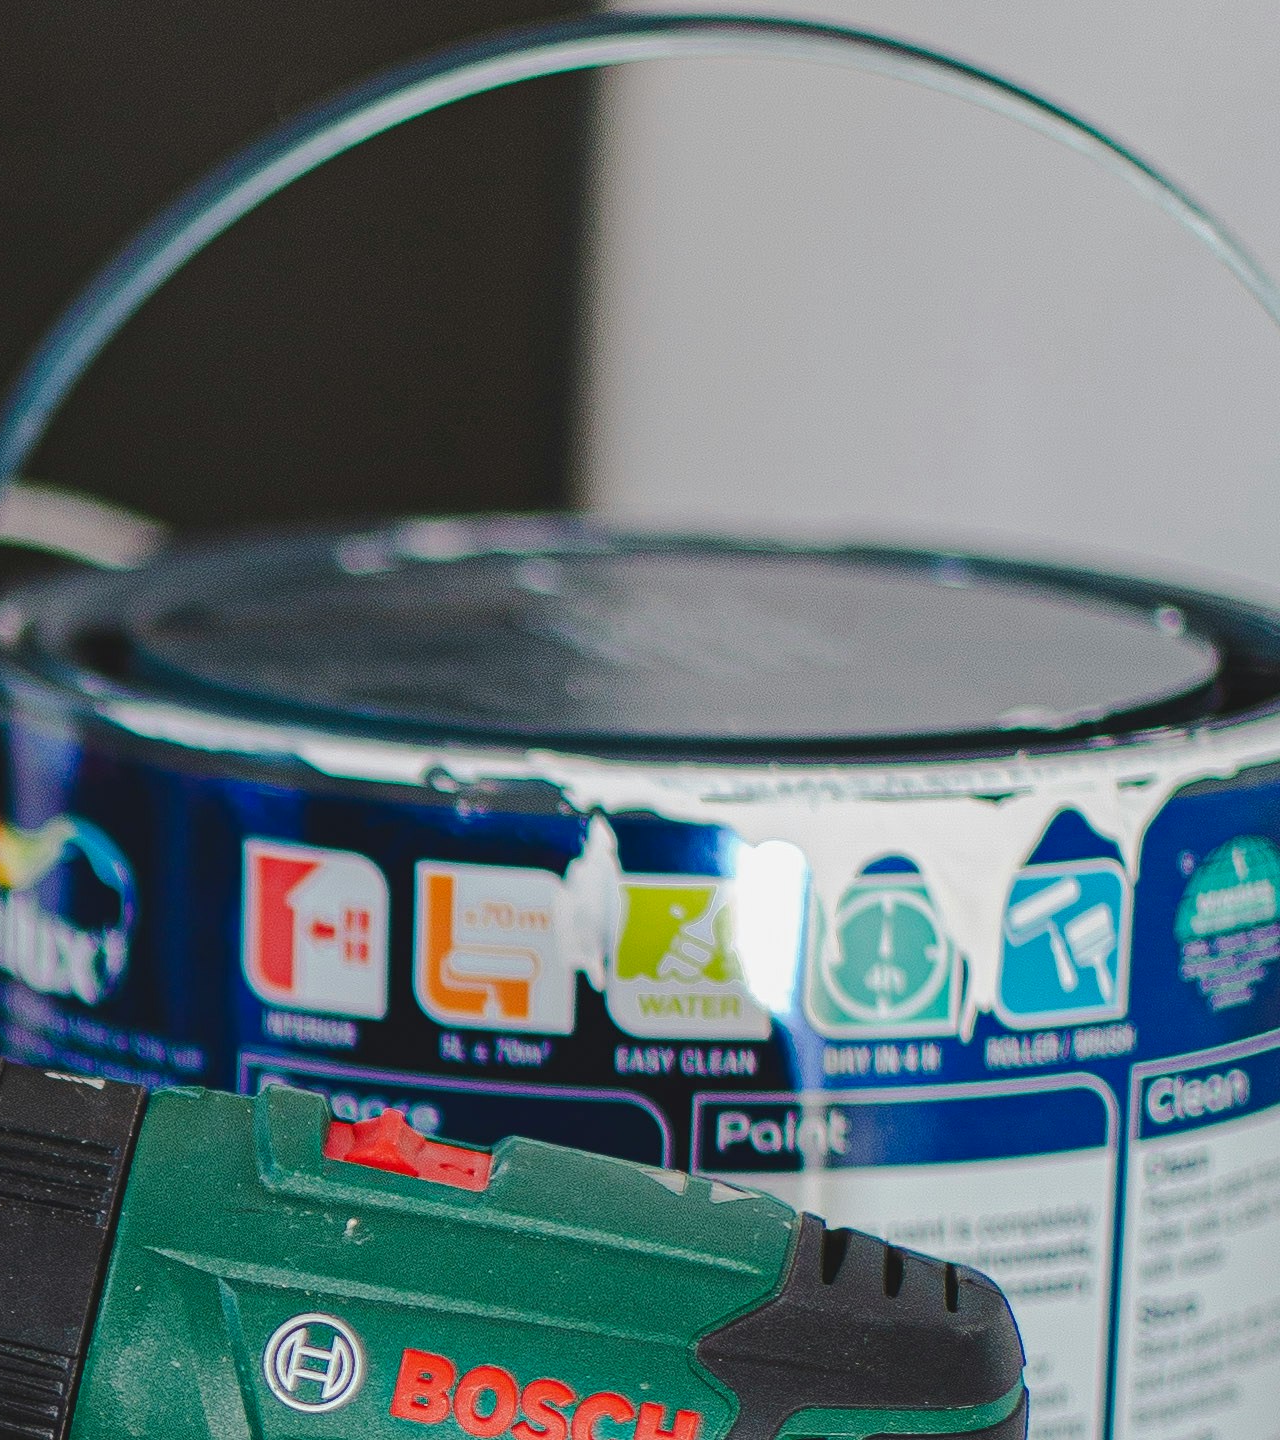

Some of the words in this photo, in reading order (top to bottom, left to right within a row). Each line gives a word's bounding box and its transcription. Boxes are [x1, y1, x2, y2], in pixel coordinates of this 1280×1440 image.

[639, 991, 741, 1020] WATER
[616, 1049, 672, 1075] EASY
[680, 1050, 757, 1076] CLEAN
[823, 1047, 869, 1077] DRY
[986, 1033, 1058, 1070] ROLLER
[1146, 1069, 1250, 1123] Clean
[716, 1111, 850, 1154] Paint
